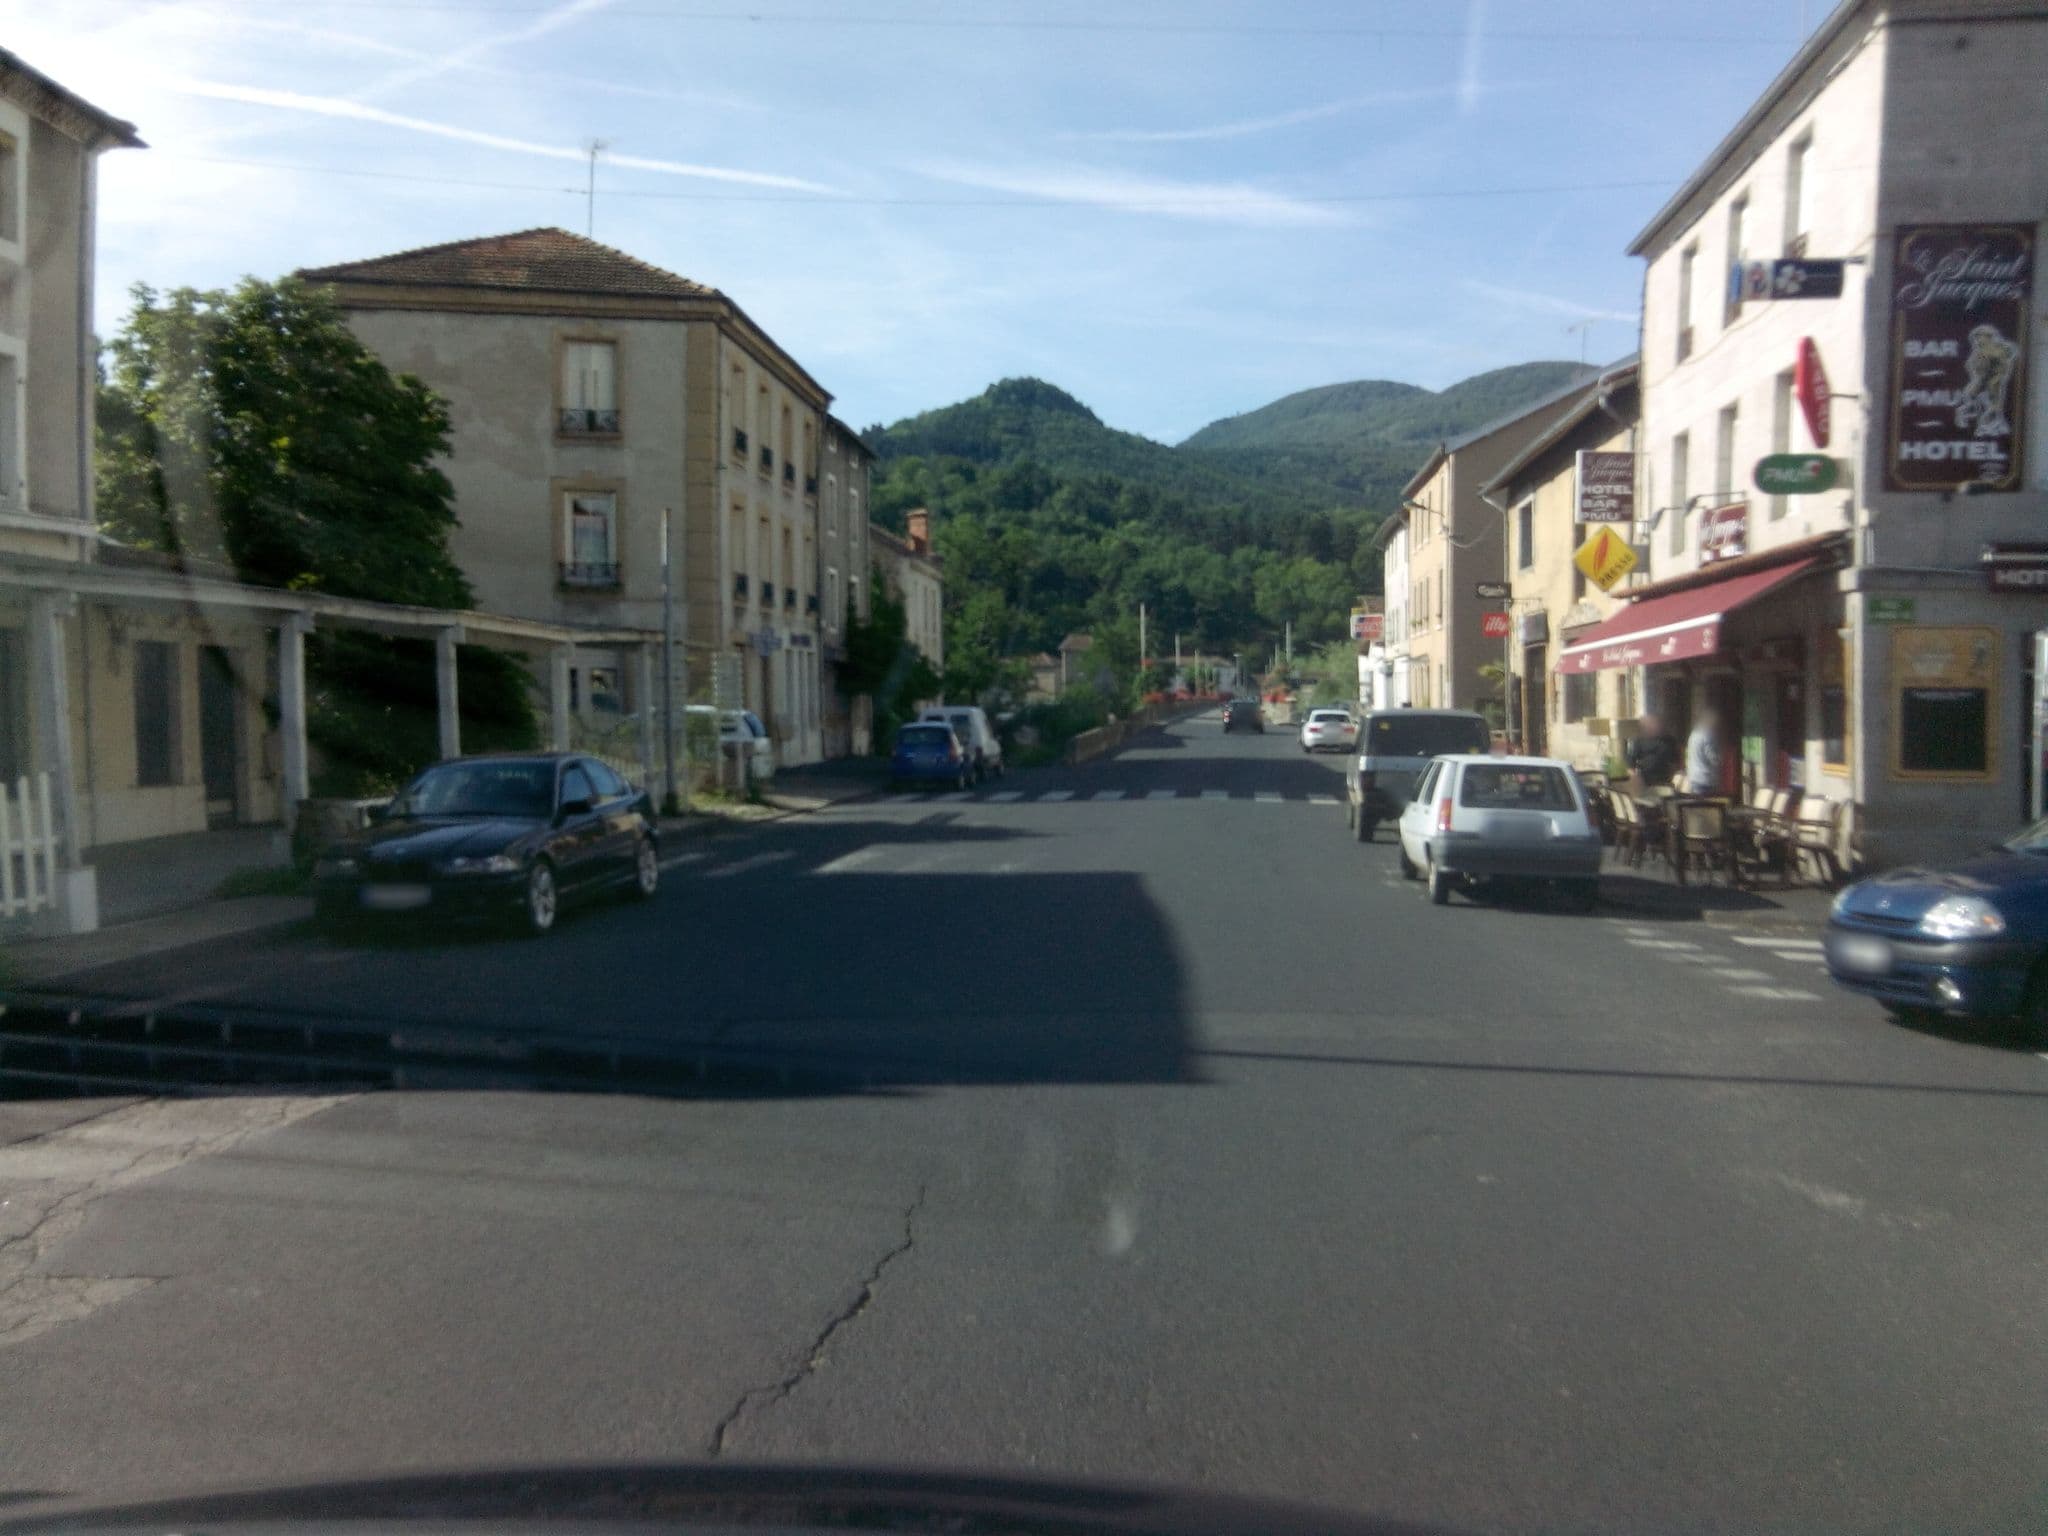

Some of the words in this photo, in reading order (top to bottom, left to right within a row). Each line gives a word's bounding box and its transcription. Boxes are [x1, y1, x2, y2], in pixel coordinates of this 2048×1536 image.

[1903, 340, 1959, 358] BAR
[1899, 441, 2008, 461] HOTEL
[1582, 484, 1633, 495] HOTEL
[1583, 499, 1618, 509] BAR
[1599, 551, 1634, 585] PRESSE
[1485, 615, 1508, 632] illy
